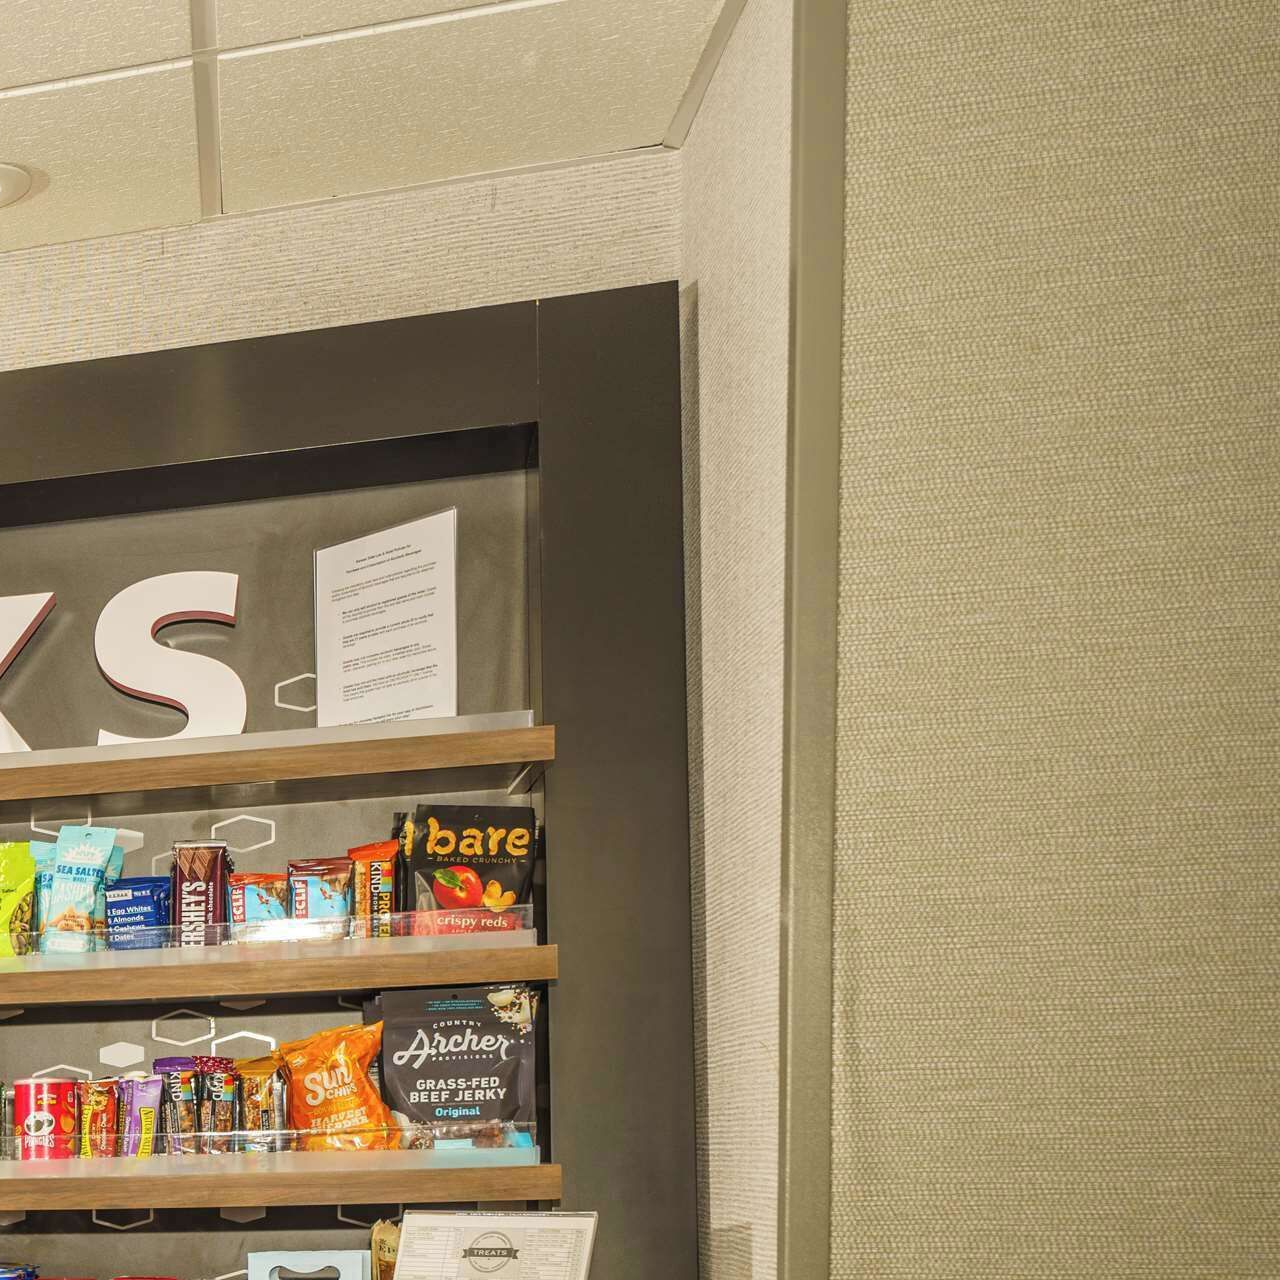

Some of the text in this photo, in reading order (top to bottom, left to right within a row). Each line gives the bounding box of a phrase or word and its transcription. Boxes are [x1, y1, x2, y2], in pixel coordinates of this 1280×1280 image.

[426, 817, 530, 856] bare
[56, 864, 73, 874] SEA
[472, 857, 517, 865] CRUNCHY
[370, 862, 382, 893] KIND
[293, 880, 307, 910] CLIF
[112, 904, 152, 916] Egg Whites
[180, 880, 206, 947] ERSHEY'S
[113, 914, 144, 923] Almonds
[437, 914, 508, 928] crispy reds
[432, 1019, 482, 1029] COUNTRY
[392, 1028, 510, 1070] Archer
[169, 1072, 182, 1101] KIND
[304, 1066, 353, 1106] Sun
[415, 1076, 500, 1091] GRASS-FED
[326, 1086, 358, 1099] CHIPS
[409, 1087, 507, 1104] BEEF JERKY
[310, 1108, 367, 1128] HARVEST
[435, 1106, 481, 1118] Original
[142, 1109, 152, 1135] NATURE
[24, 1134, 55, 1147] PRINGLES
